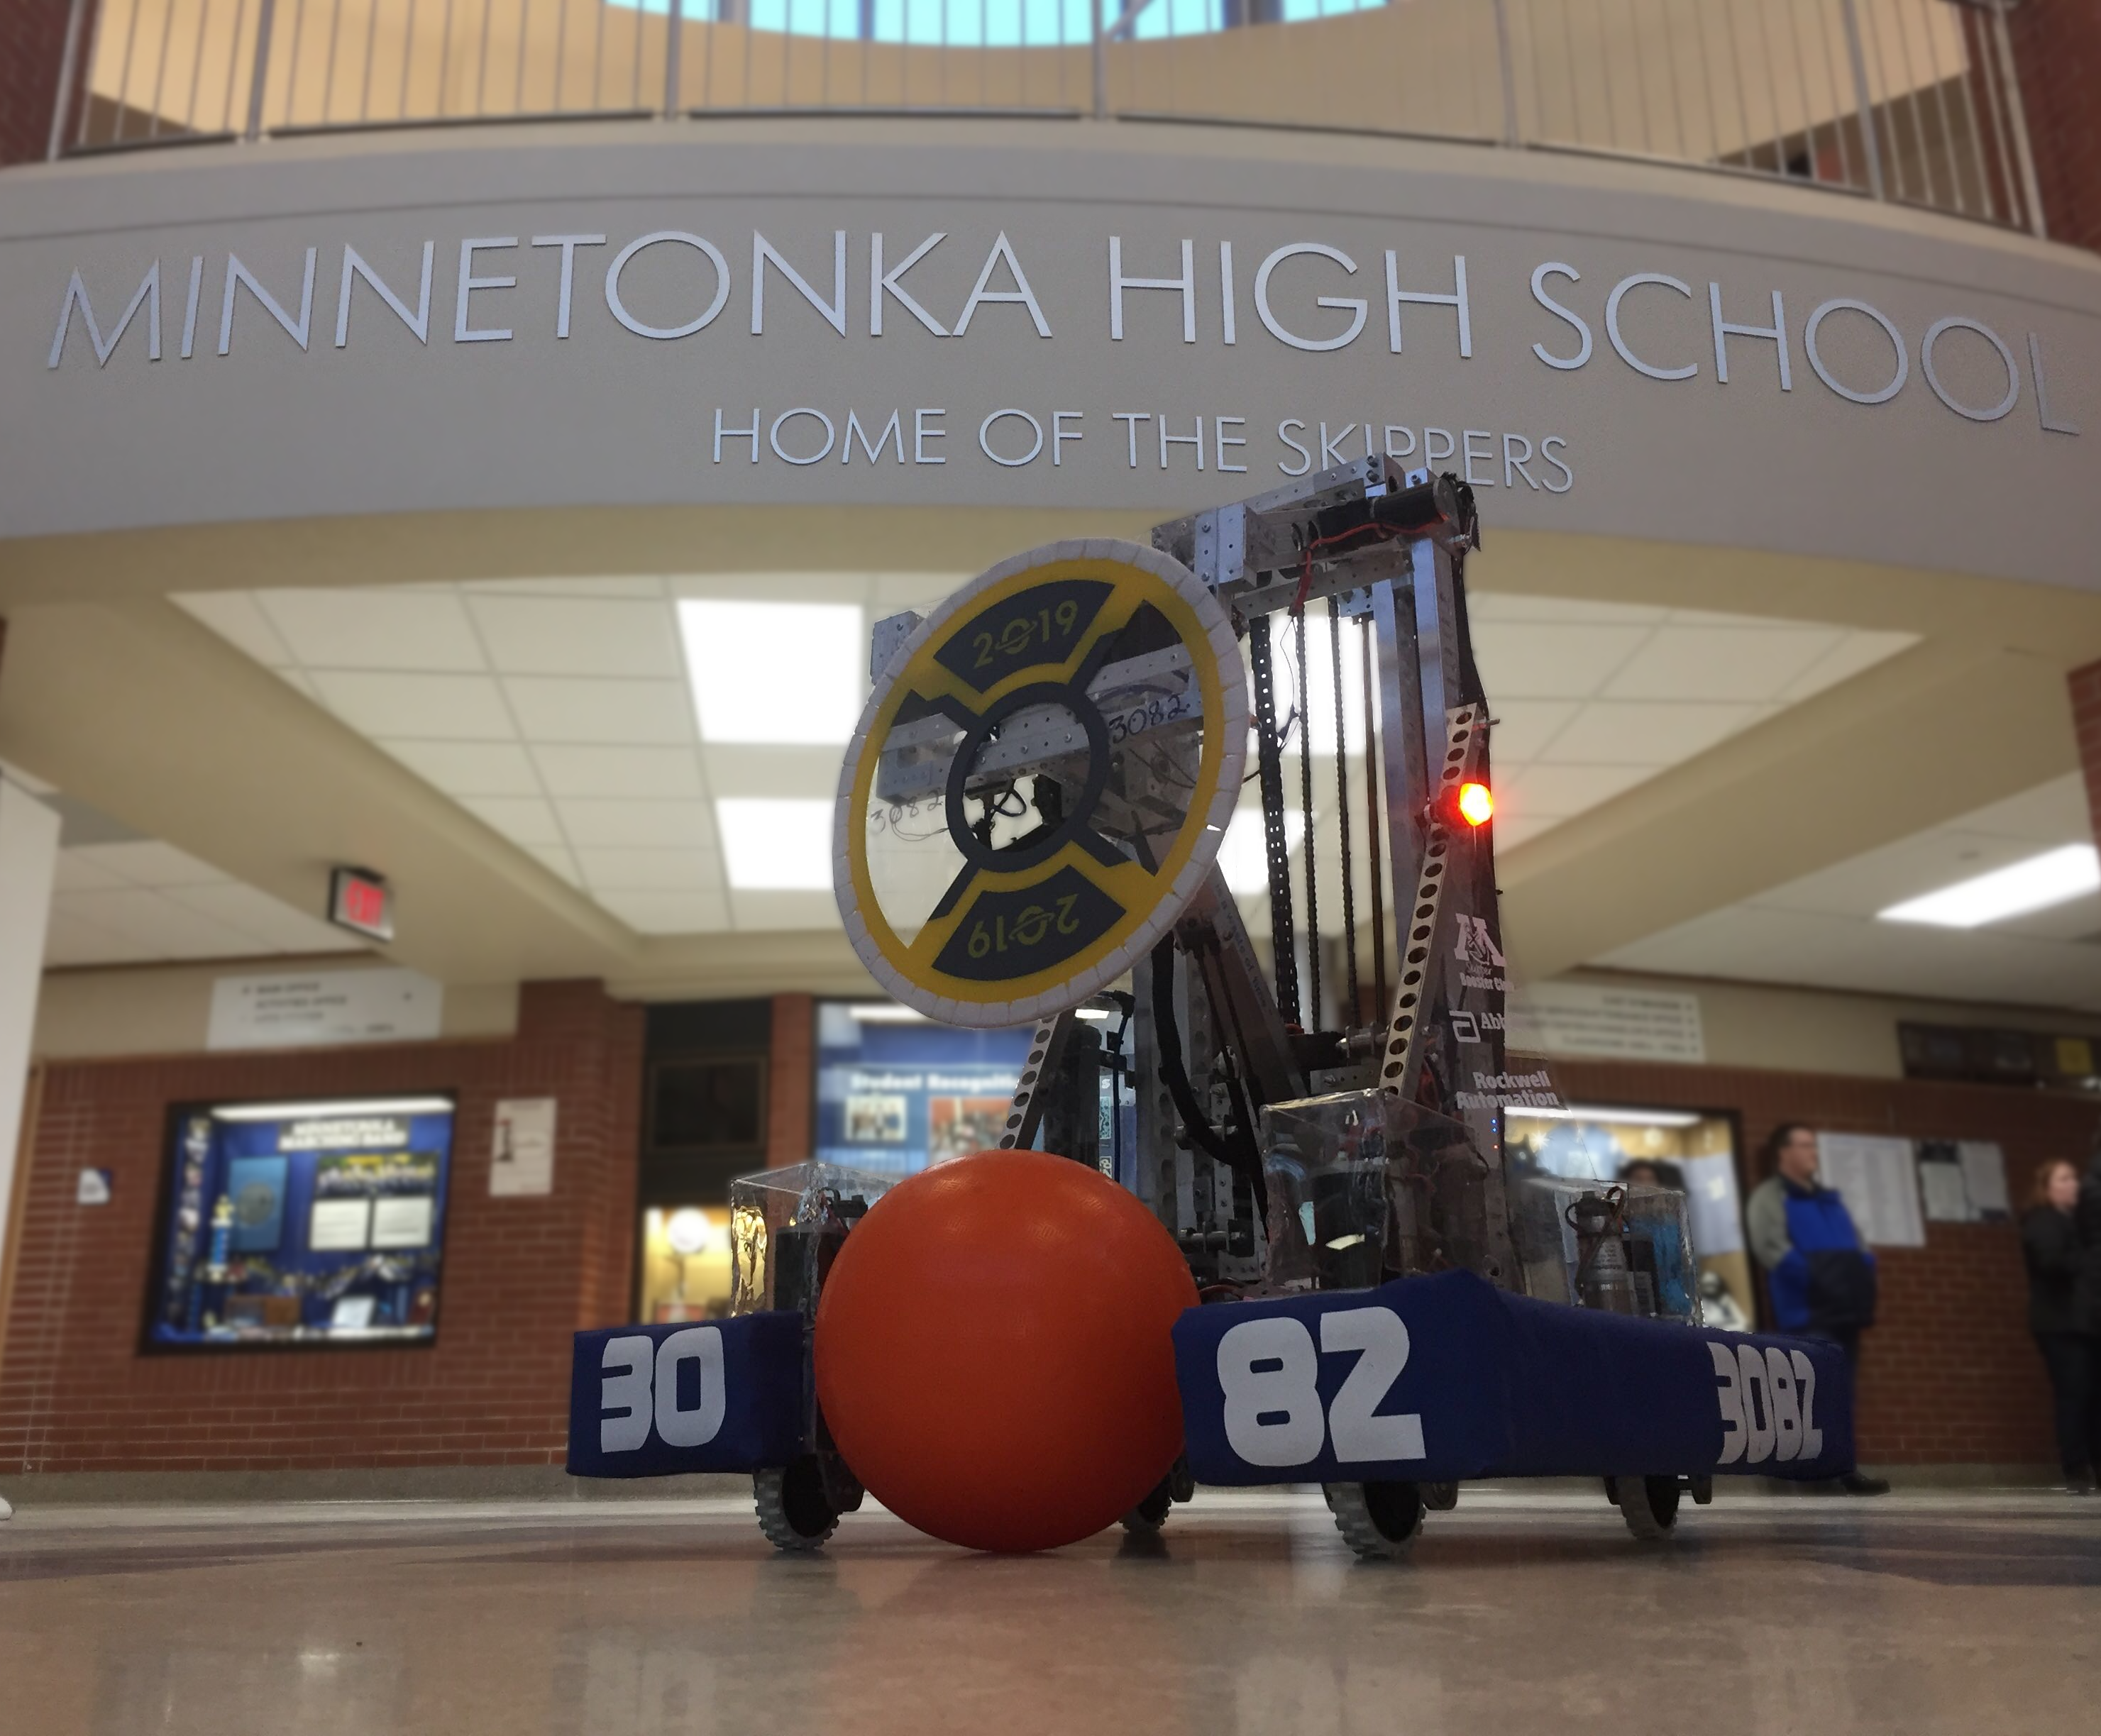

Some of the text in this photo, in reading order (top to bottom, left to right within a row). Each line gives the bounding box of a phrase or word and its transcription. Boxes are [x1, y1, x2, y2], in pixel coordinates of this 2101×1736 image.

[46, 228, 2080, 435] MINNETONKA HIGH SCHOOL
[713, 407, 1573, 493] HOME OF THE SKIPPERS
[972, 599, 1079, 670] 2019
[1108, 694, 1188, 744] 3082
[967, 892, 1080, 959] 2019
[1455, 1089, 1560, 1110] Automation
[1472, 1070, 1552, 1090] Rockwell
[600, 1305, 1427, 1468] 30 82
[1706, 1341, 1824, 1465] 3082
